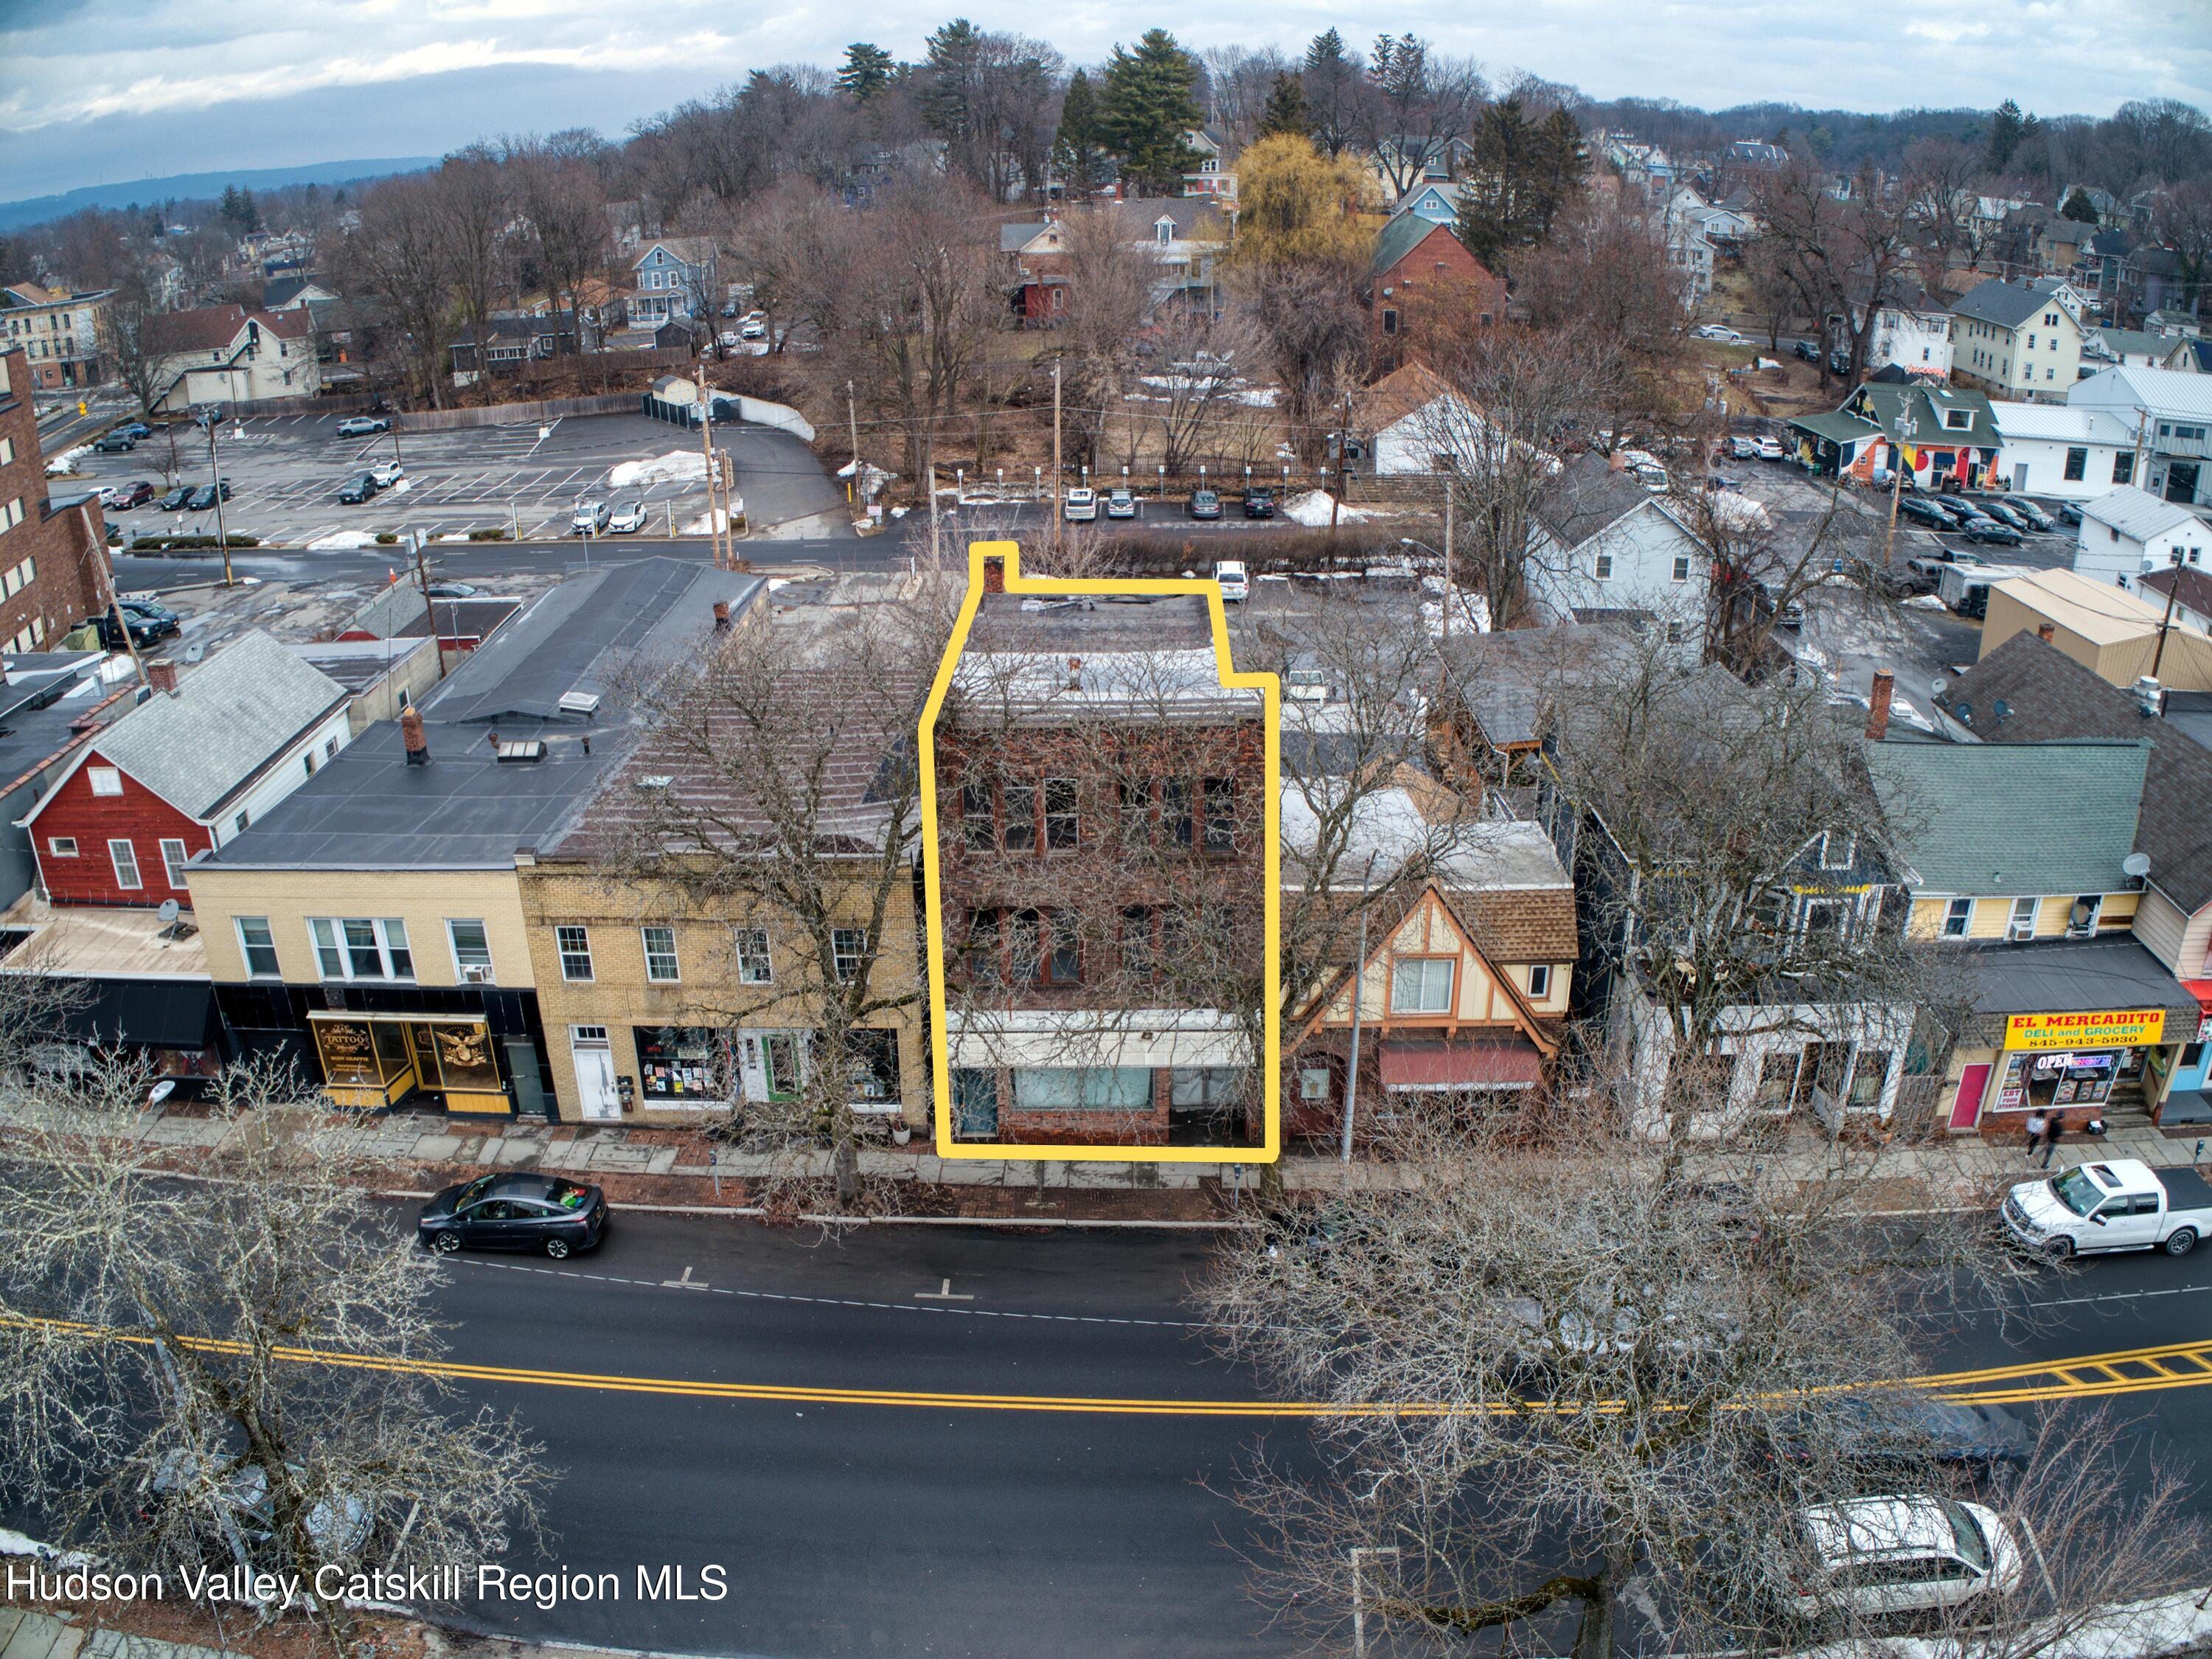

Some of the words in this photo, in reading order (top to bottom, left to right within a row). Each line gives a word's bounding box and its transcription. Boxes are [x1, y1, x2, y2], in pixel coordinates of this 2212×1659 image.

[2012, 1017, 2037, 1028] EL
[2045, 1012, 2160, 1027] MERCADITO
[2024, 1029, 2053, 1038] DELI
[2084, 1026, 2146, 1036] GROCERY
[325, 1035, 364, 1043] TATTOO
[2029, 1036, 2138, 1047] 845-943-5930
[2037, 1053, 2073, 1069] OPEN
